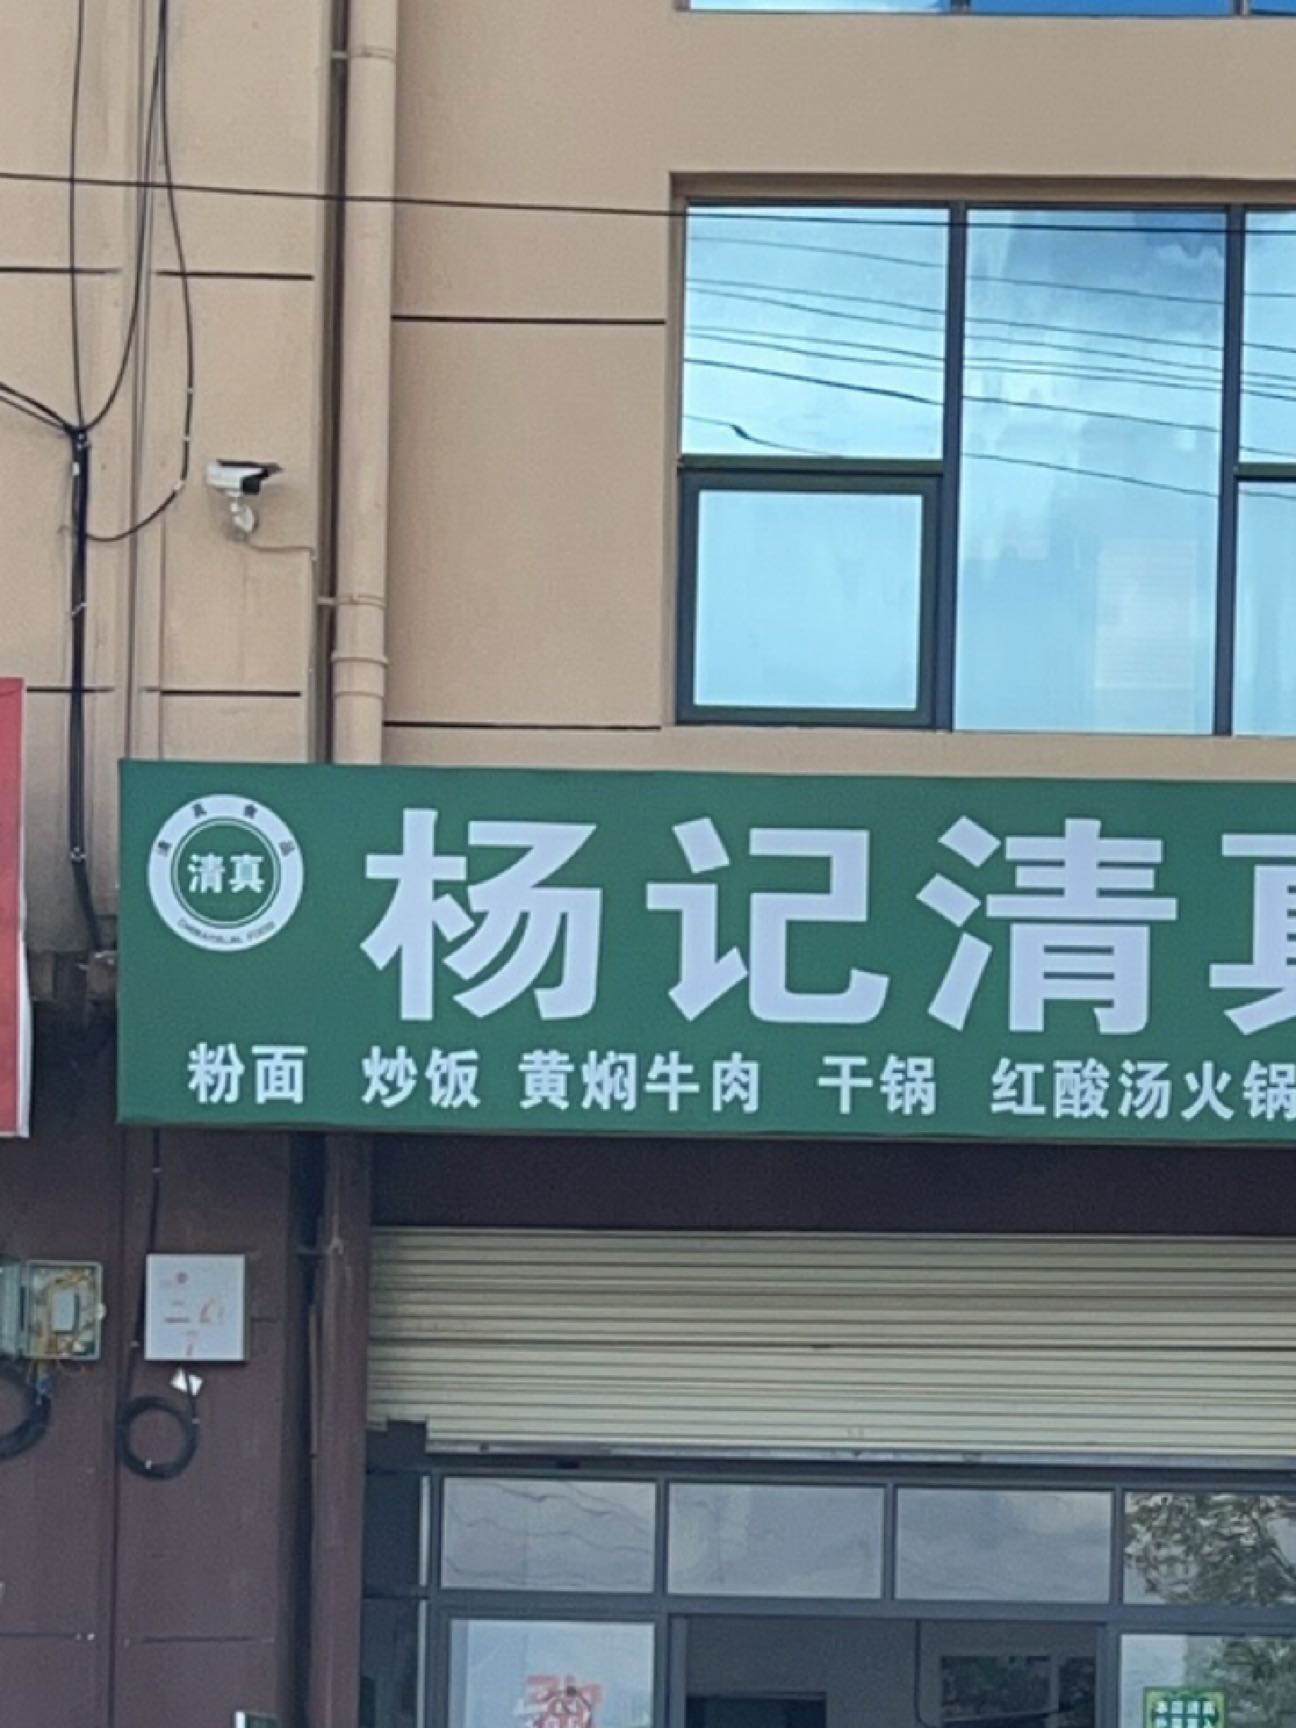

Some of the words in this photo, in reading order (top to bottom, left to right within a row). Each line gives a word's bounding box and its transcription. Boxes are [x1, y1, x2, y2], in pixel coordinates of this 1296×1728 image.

[187, 853, 265, 894] 清真
[188, 1043, 307, 1104] 粉面
[362, 1046, 480, 1108] 炒饭
[518, 1049, 760, 1112] 黄焖牛肉
[818, 1055, 936, 1116] 干锅
